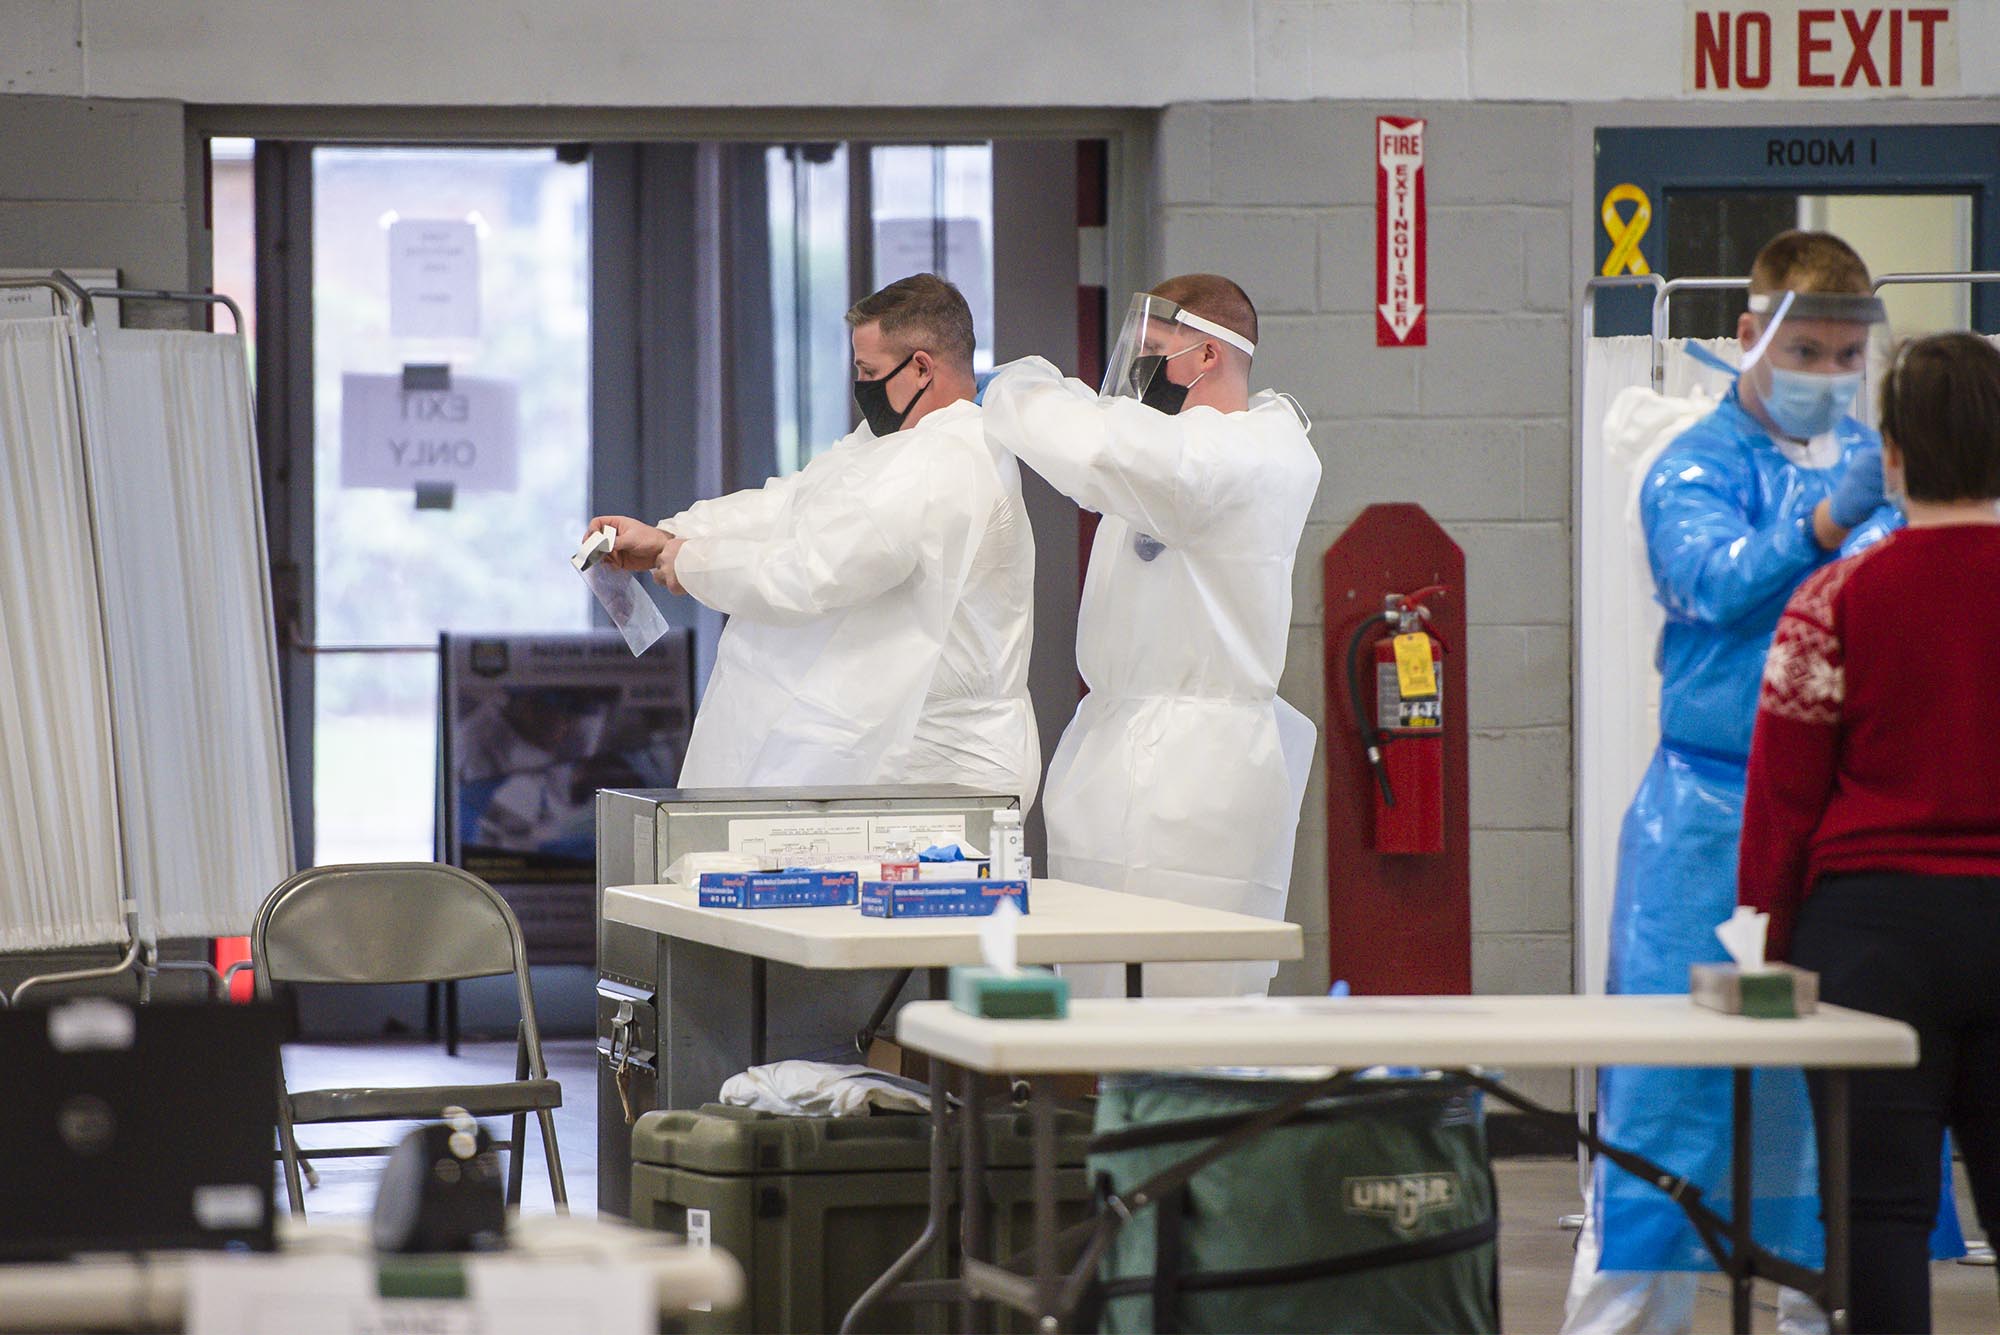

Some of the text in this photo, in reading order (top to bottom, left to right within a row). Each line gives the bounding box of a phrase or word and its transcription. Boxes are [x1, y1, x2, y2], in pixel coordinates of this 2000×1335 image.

[1695, 9, 1948, 90] NO EXIT
[1384, 135, 1420, 155] FIRE
[1767, 138, 1854, 165] ROOM
[1394, 164, 1408, 327] EXTINGUISHER
